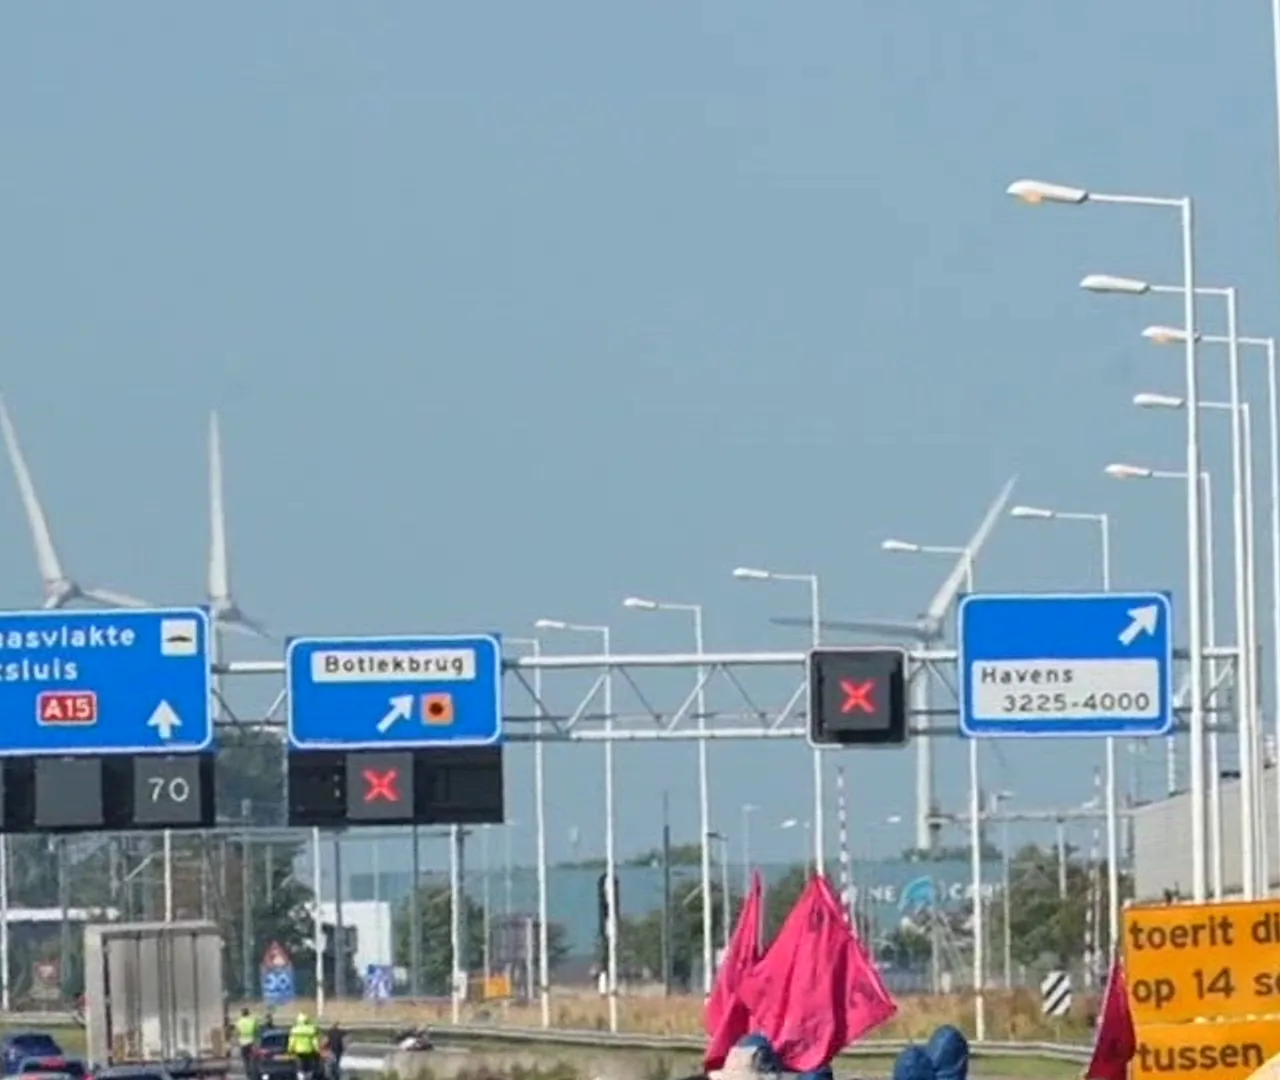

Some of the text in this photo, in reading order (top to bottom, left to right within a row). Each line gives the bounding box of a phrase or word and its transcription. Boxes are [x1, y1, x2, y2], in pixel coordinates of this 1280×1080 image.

[325, 655, 463, 675] Botlekbrug
[981, 667, 1073, 684] Havens
[43, 697, 91, 719] A15
[1002, 693, 1150, 712] 3225-4000
[148, 777, 189, 802] 70
[1129, 916, 1234, 950] toerit
[1132, 977, 1175, 1008] op
[1193, 967, 1235, 1000] 14
[1138, 1043, 1264, 1073] tussen
